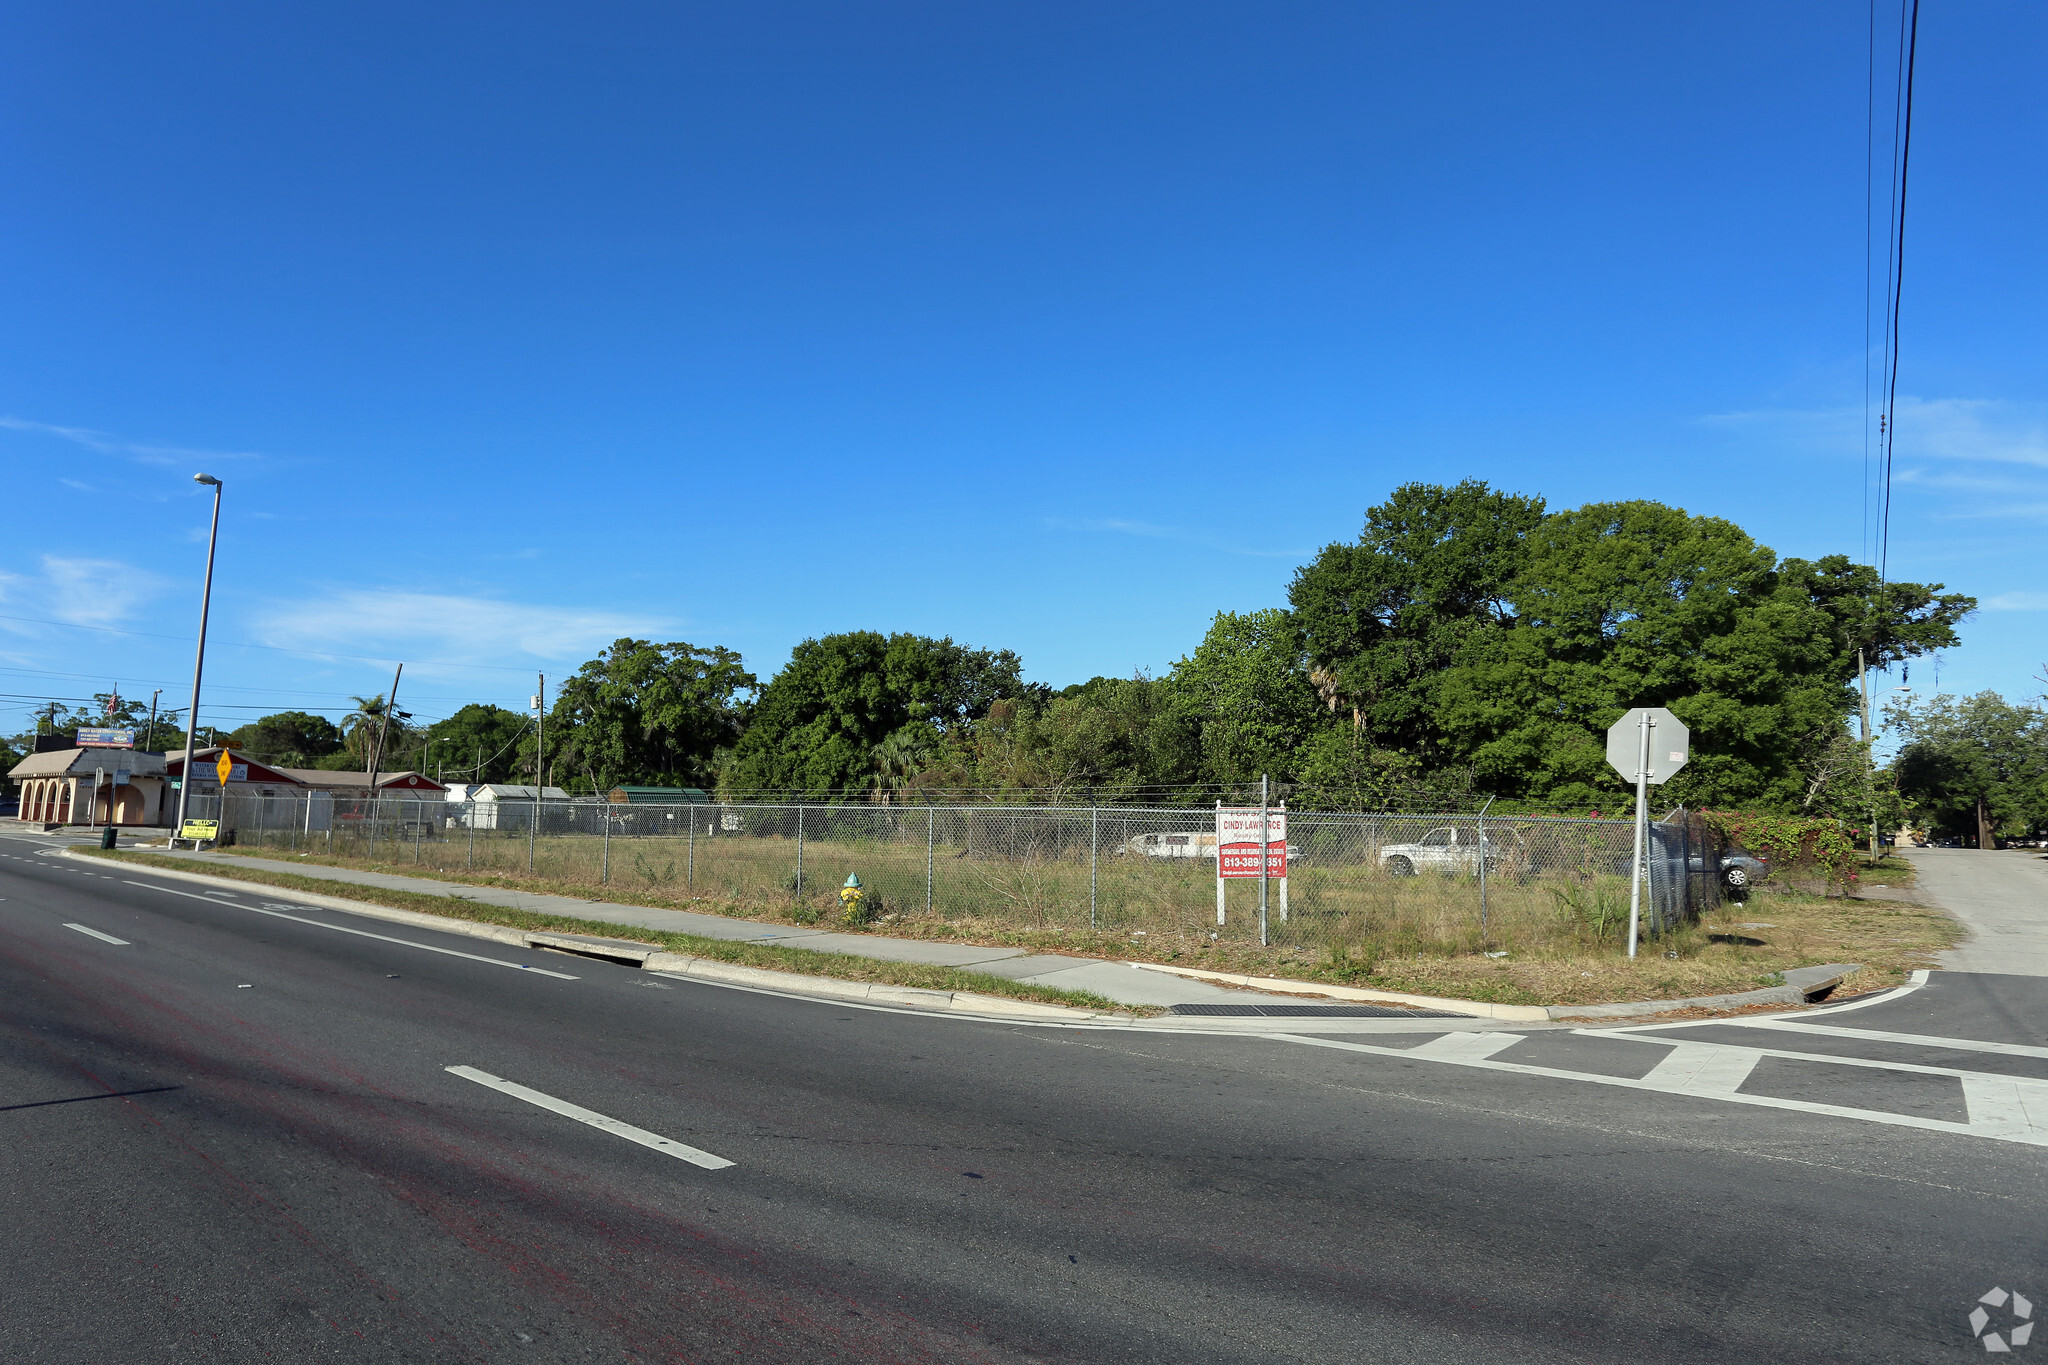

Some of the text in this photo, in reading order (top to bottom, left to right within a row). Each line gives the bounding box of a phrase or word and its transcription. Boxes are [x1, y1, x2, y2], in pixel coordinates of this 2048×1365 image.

[1223, 820, 1281, 830] CINDY LAWRNCE
[1233, 832, 1253, 840] Realty
[1224, 857, 1282, 867] 813-389-351
